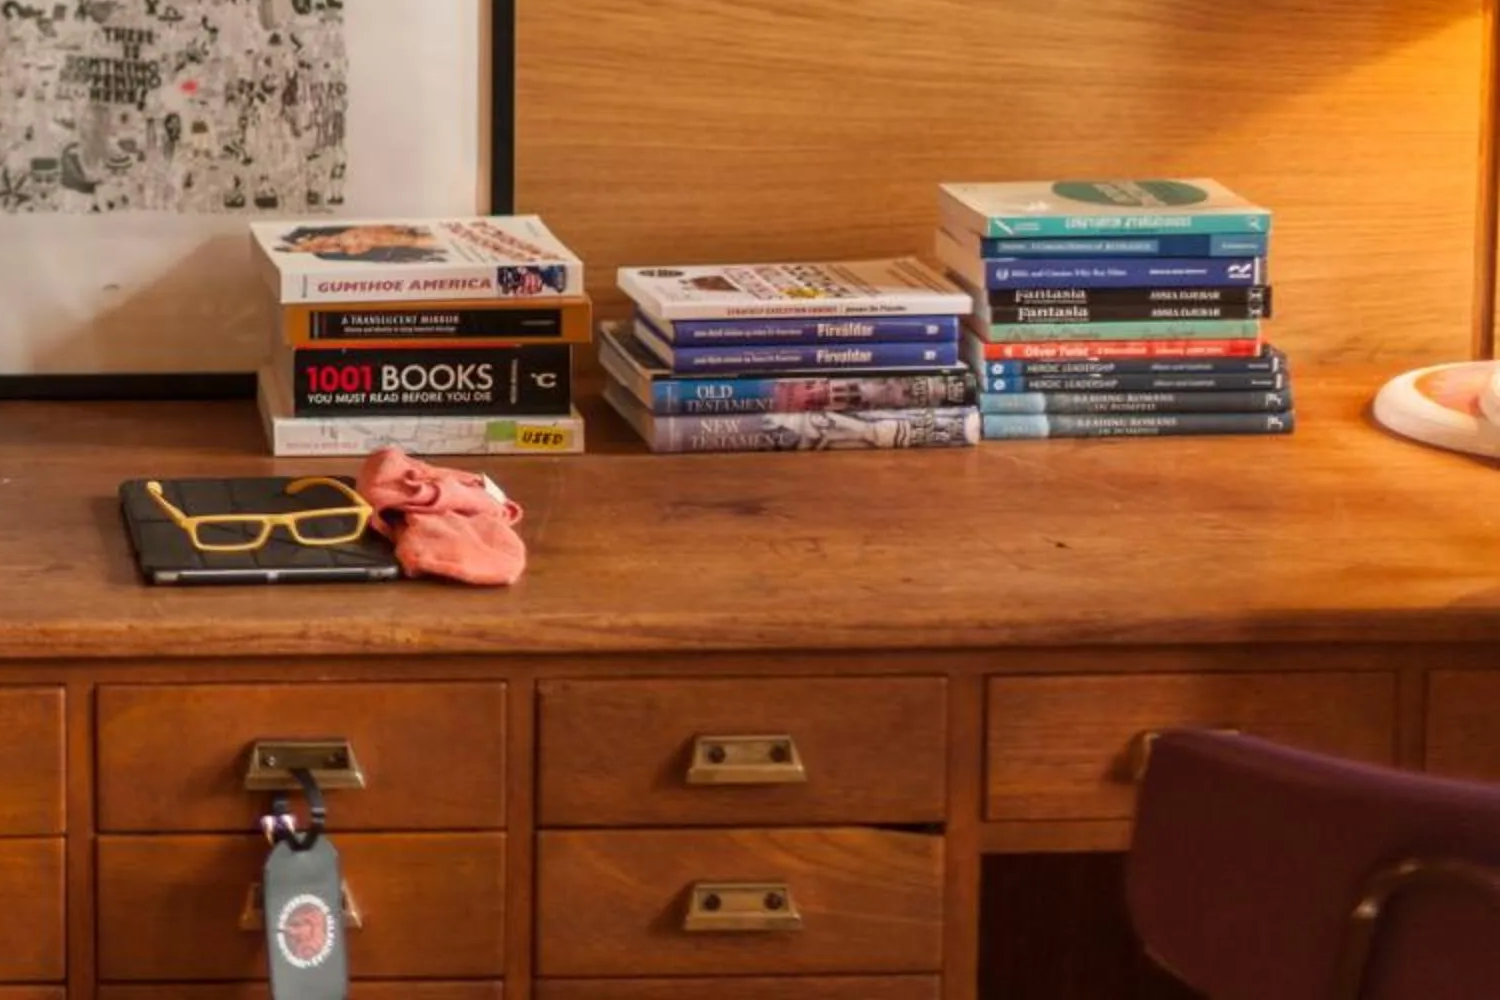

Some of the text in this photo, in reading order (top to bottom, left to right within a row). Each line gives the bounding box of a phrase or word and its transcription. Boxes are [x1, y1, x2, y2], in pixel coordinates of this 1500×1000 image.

[317, 279, 404, 293] GUMSHOE
[408, 277, 492, 291] AMERICA
[307, 366, 372, 392] 1001
[381, 364, 494, 391] BOOKS
[308, 391, 492, 404] YOU MUST READ BEFORE YOU DIE
[696, 385, 733, 399] OLD
[687, 399, 774, 412] TESTAMENT
[700, 419, 740, 433] NEW
[522, 431, 564, 445] USED
[691, 434, 785, 449] TESTAMENT
